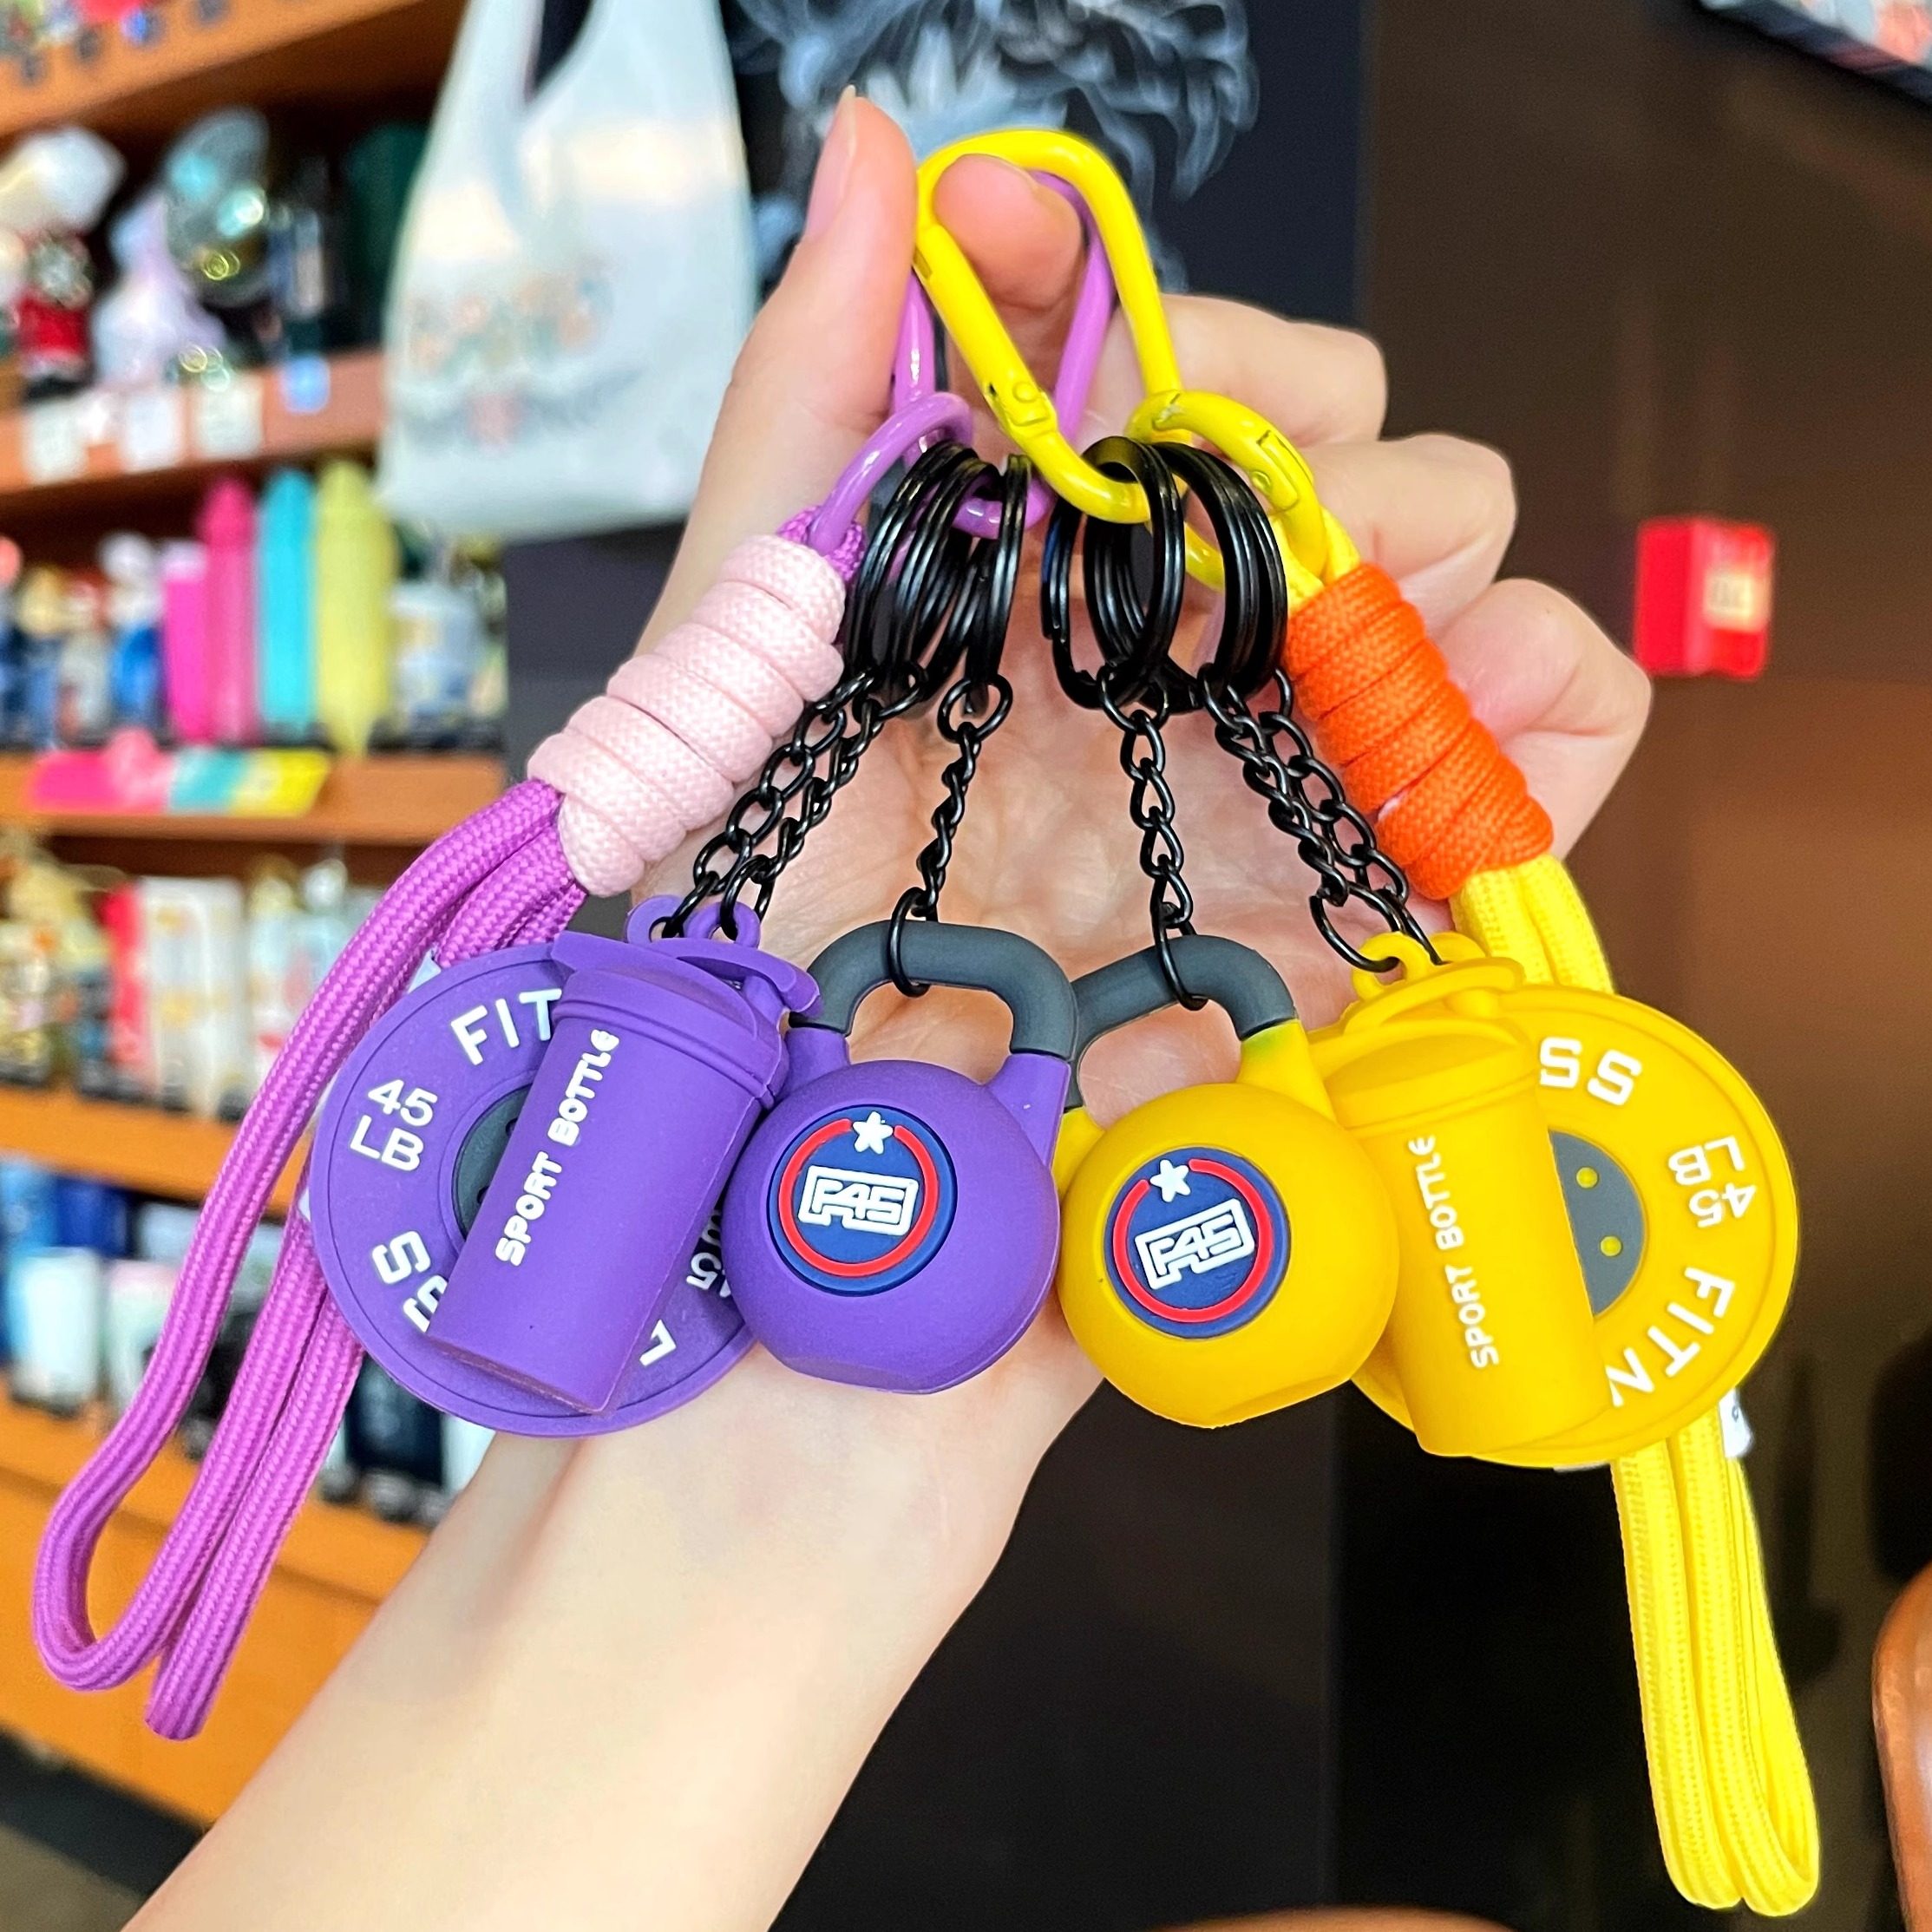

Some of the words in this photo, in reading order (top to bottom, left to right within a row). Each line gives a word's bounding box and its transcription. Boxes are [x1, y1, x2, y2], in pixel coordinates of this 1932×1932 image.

[449, 987, 562, 1066] FIT
[367, 1079, 438, 1127] 45
[1539, 1036, 1642, 1106] SS
[350, 1114, 425, 1172] LB
[494, 1150, 562, 1267] SPORT
[547, 1029, 619, 1147] BOTTLE
[1667, 1135, 1745, 1186] LB
[807, 1173, 911, 1229] F45
[1407, 1134, 1464, 1250] BOTTLE
[1688, 1182, 1757, 1228] 45
[1143, 1207, 1248, 1281] F45
[371, 1230, 449, 1333] SS
[1444, 1263, 1499, 1369] SPORT
[1605, 1267, 1735, 1407] FITN
